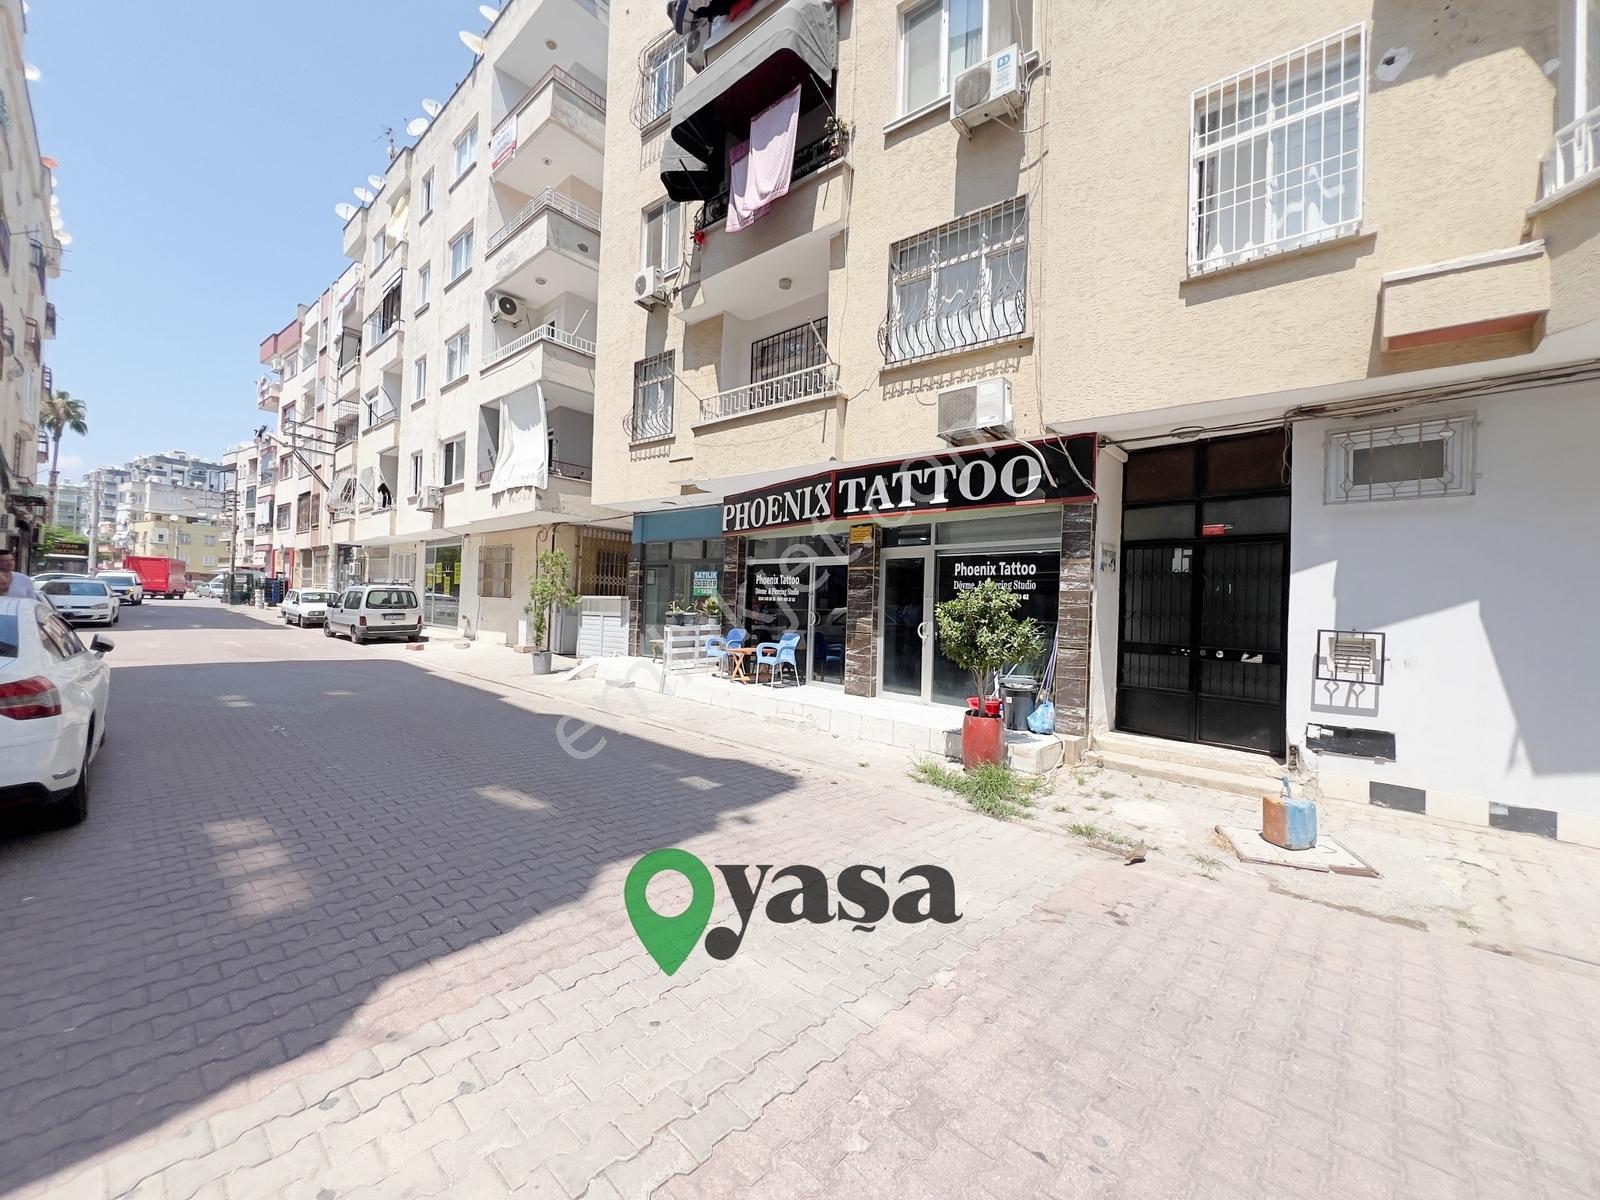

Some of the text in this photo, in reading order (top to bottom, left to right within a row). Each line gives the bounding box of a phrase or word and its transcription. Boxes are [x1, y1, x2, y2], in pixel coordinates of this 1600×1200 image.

[722, 455, 1042, 532] PHOENIX TATTOO
[954, 561, 1036, 576] Phoenix Tattoo
[755, 574, 800, 585] Phoenix Tattoo
[1013, 579, 1036, 590] Studio
